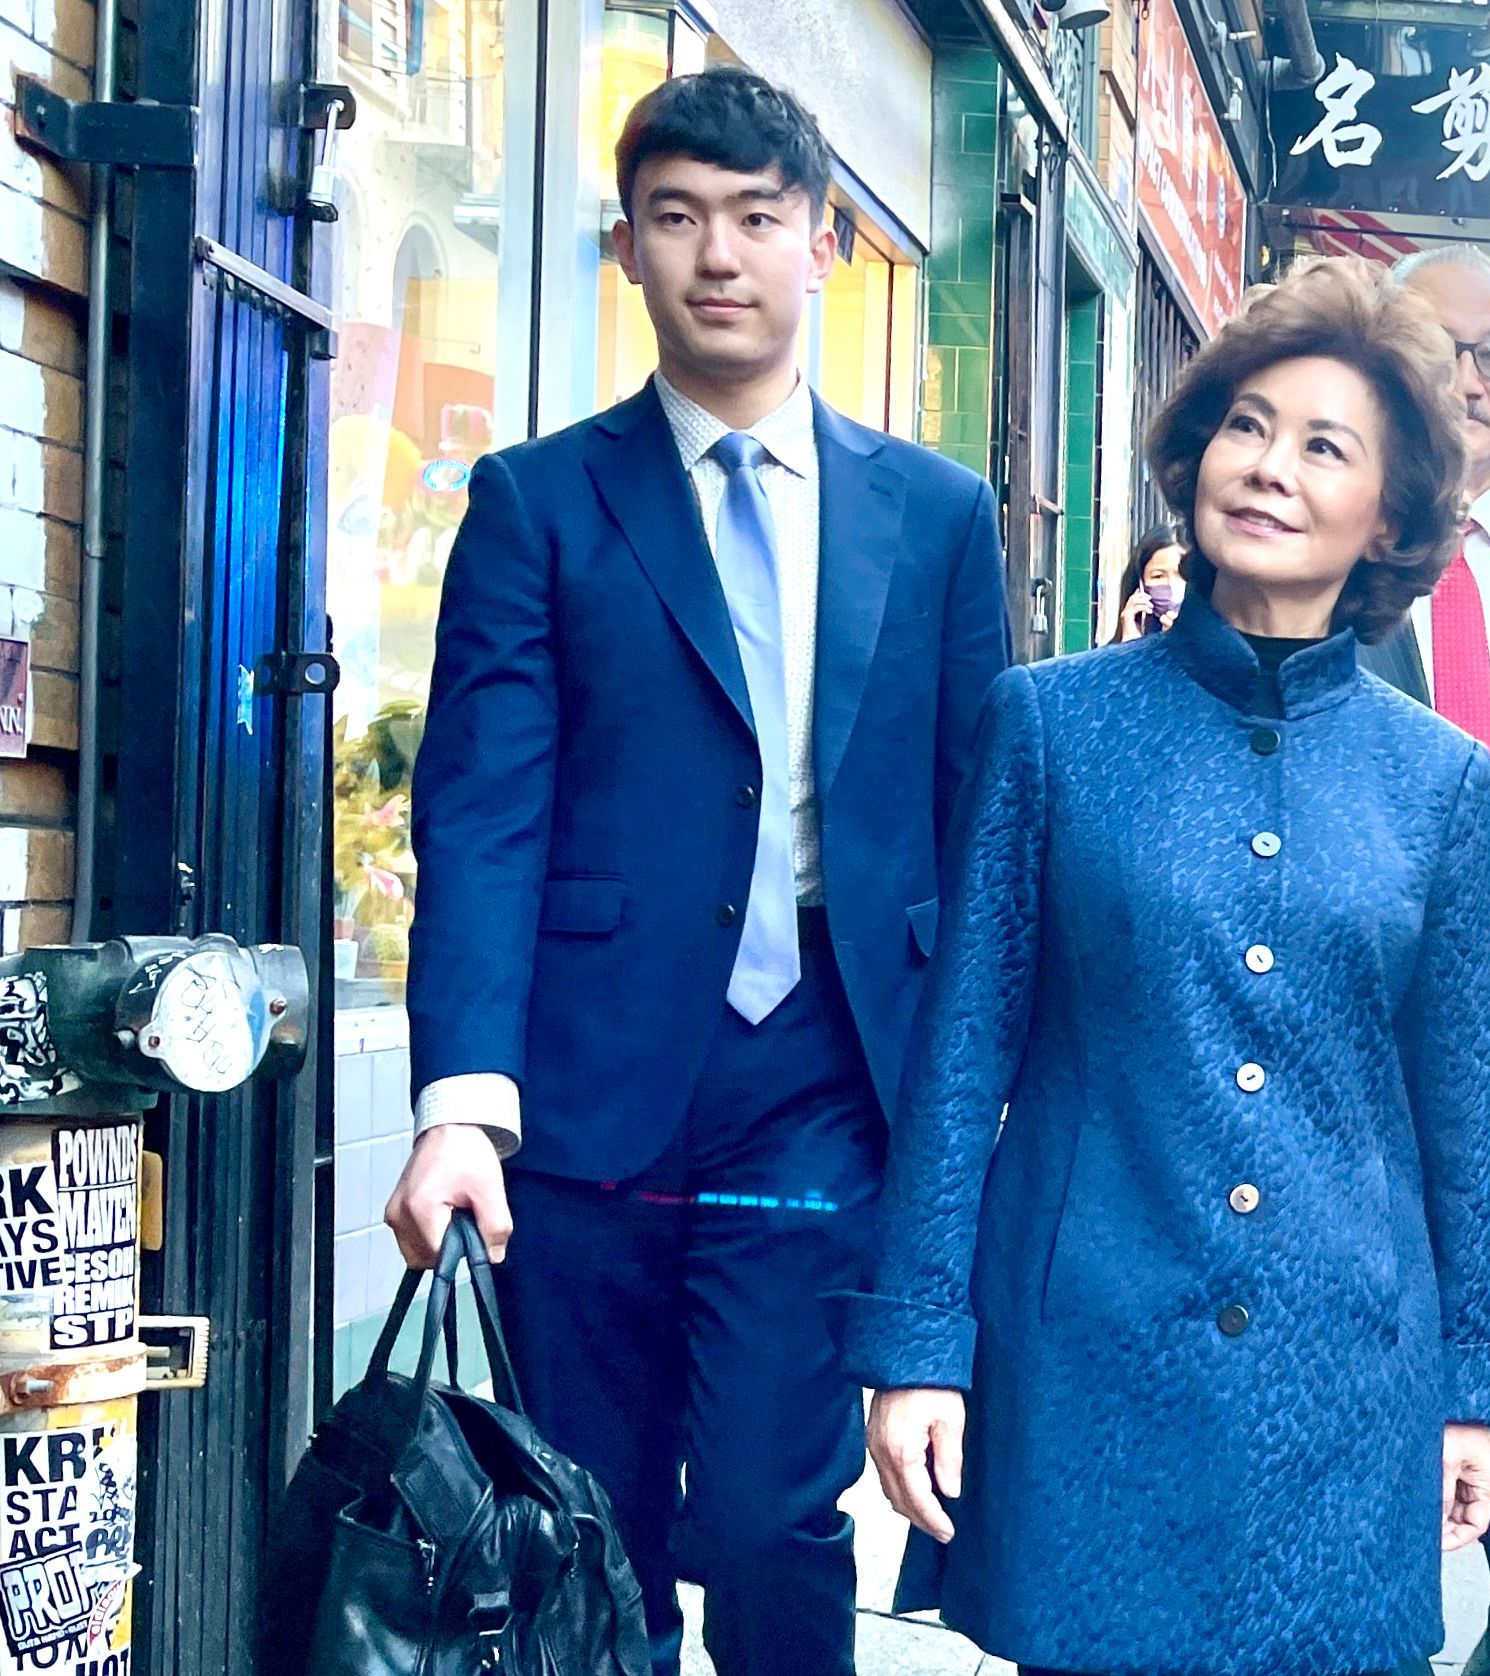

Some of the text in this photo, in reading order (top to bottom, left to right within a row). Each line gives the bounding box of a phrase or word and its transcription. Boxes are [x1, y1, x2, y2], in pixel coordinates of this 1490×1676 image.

[58, 1123, 137, 1188] POWNDS
[57, 1183, 136, 1250] MAVEN
[53, 1308, 133, 1347] STP
